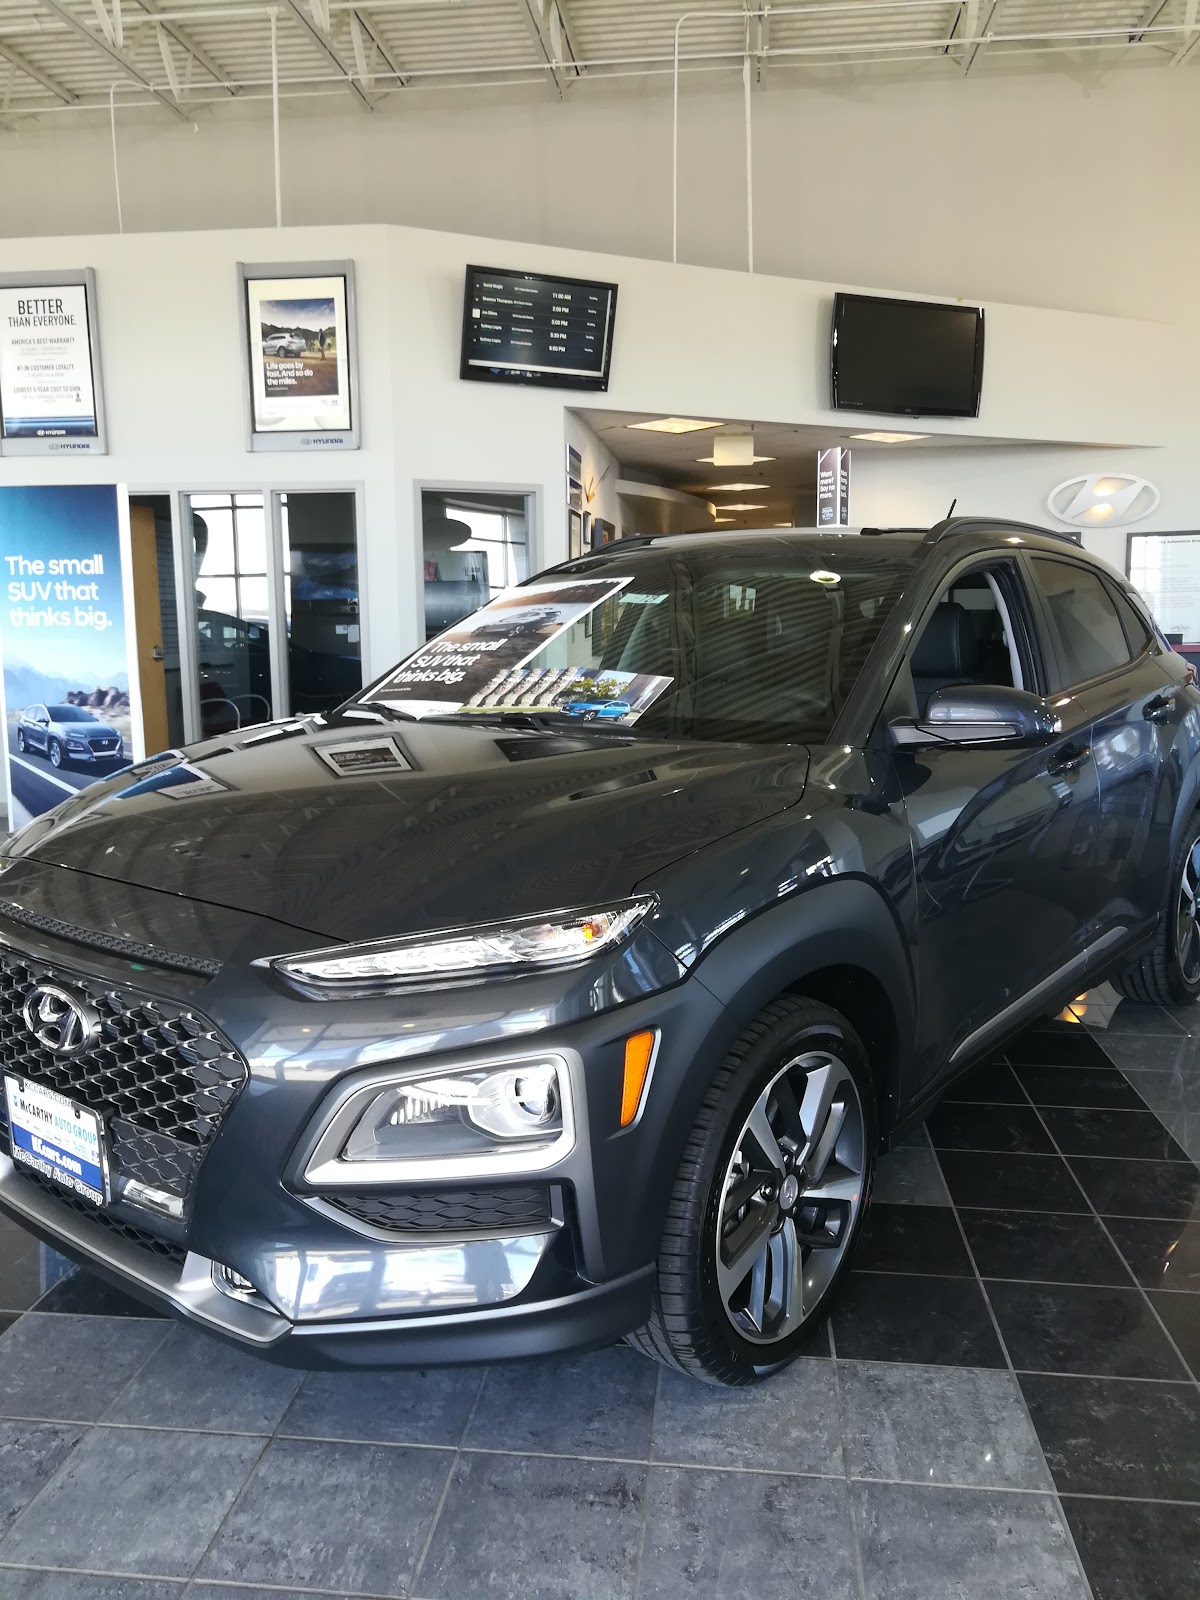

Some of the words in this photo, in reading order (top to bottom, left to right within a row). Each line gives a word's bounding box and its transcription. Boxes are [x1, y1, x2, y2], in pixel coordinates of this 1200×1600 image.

[17, 298, 65, 316] BETTER
[7, 316, 31, 328] THAN
[32, 314, 77, 327] EVERYONE.
[560, 319, 569, 327] PM
[11, 338, 36, 346] AMERICA'S
[36, 337, 48, 345] BEST
[559, 332, 568, 340] PM
[558, 345, 567, 353] PM
[24, 364, 30, 372] IN
[55, 363, 75, 371] LOYALTY
[278, 363, 295, 371] goes
[294, 362, 304, 370] by
[303, 369, 314, 377] do
[267, 378, 279, 386] the
[278, 377, 298, 385] miles.
[820, 477, 835, 485] more?
[4, 555, 46, 576] The
[48, 553, 104, 576] small
[7, 581, 53, 602] SUV
[53, 580, 100, 601] that
[9, 606, 72, 628] thinks
[73, 605, 113, 631] big.
[430, 641, 462, 653] The
[459, 638, 508, 653] small
[410, 654, 449, 668] SUV
[442, 653, 481, 667] that
[393, 669, 440, 684] thinks
[436, 668, 467, 685] big.
[19, 1098, 53, 1125] McCARTHY
[54, 1115, 72, 1134] AUTO
[72, 1126, 98, 1145] GROUP
[31, 1134, 83, 1176] KCcars.com
[12, 1144, 53, 1179] McCarthy
[52, 1167, 75, 1189] Auto
[73, 1179, 104, 1206] Group
